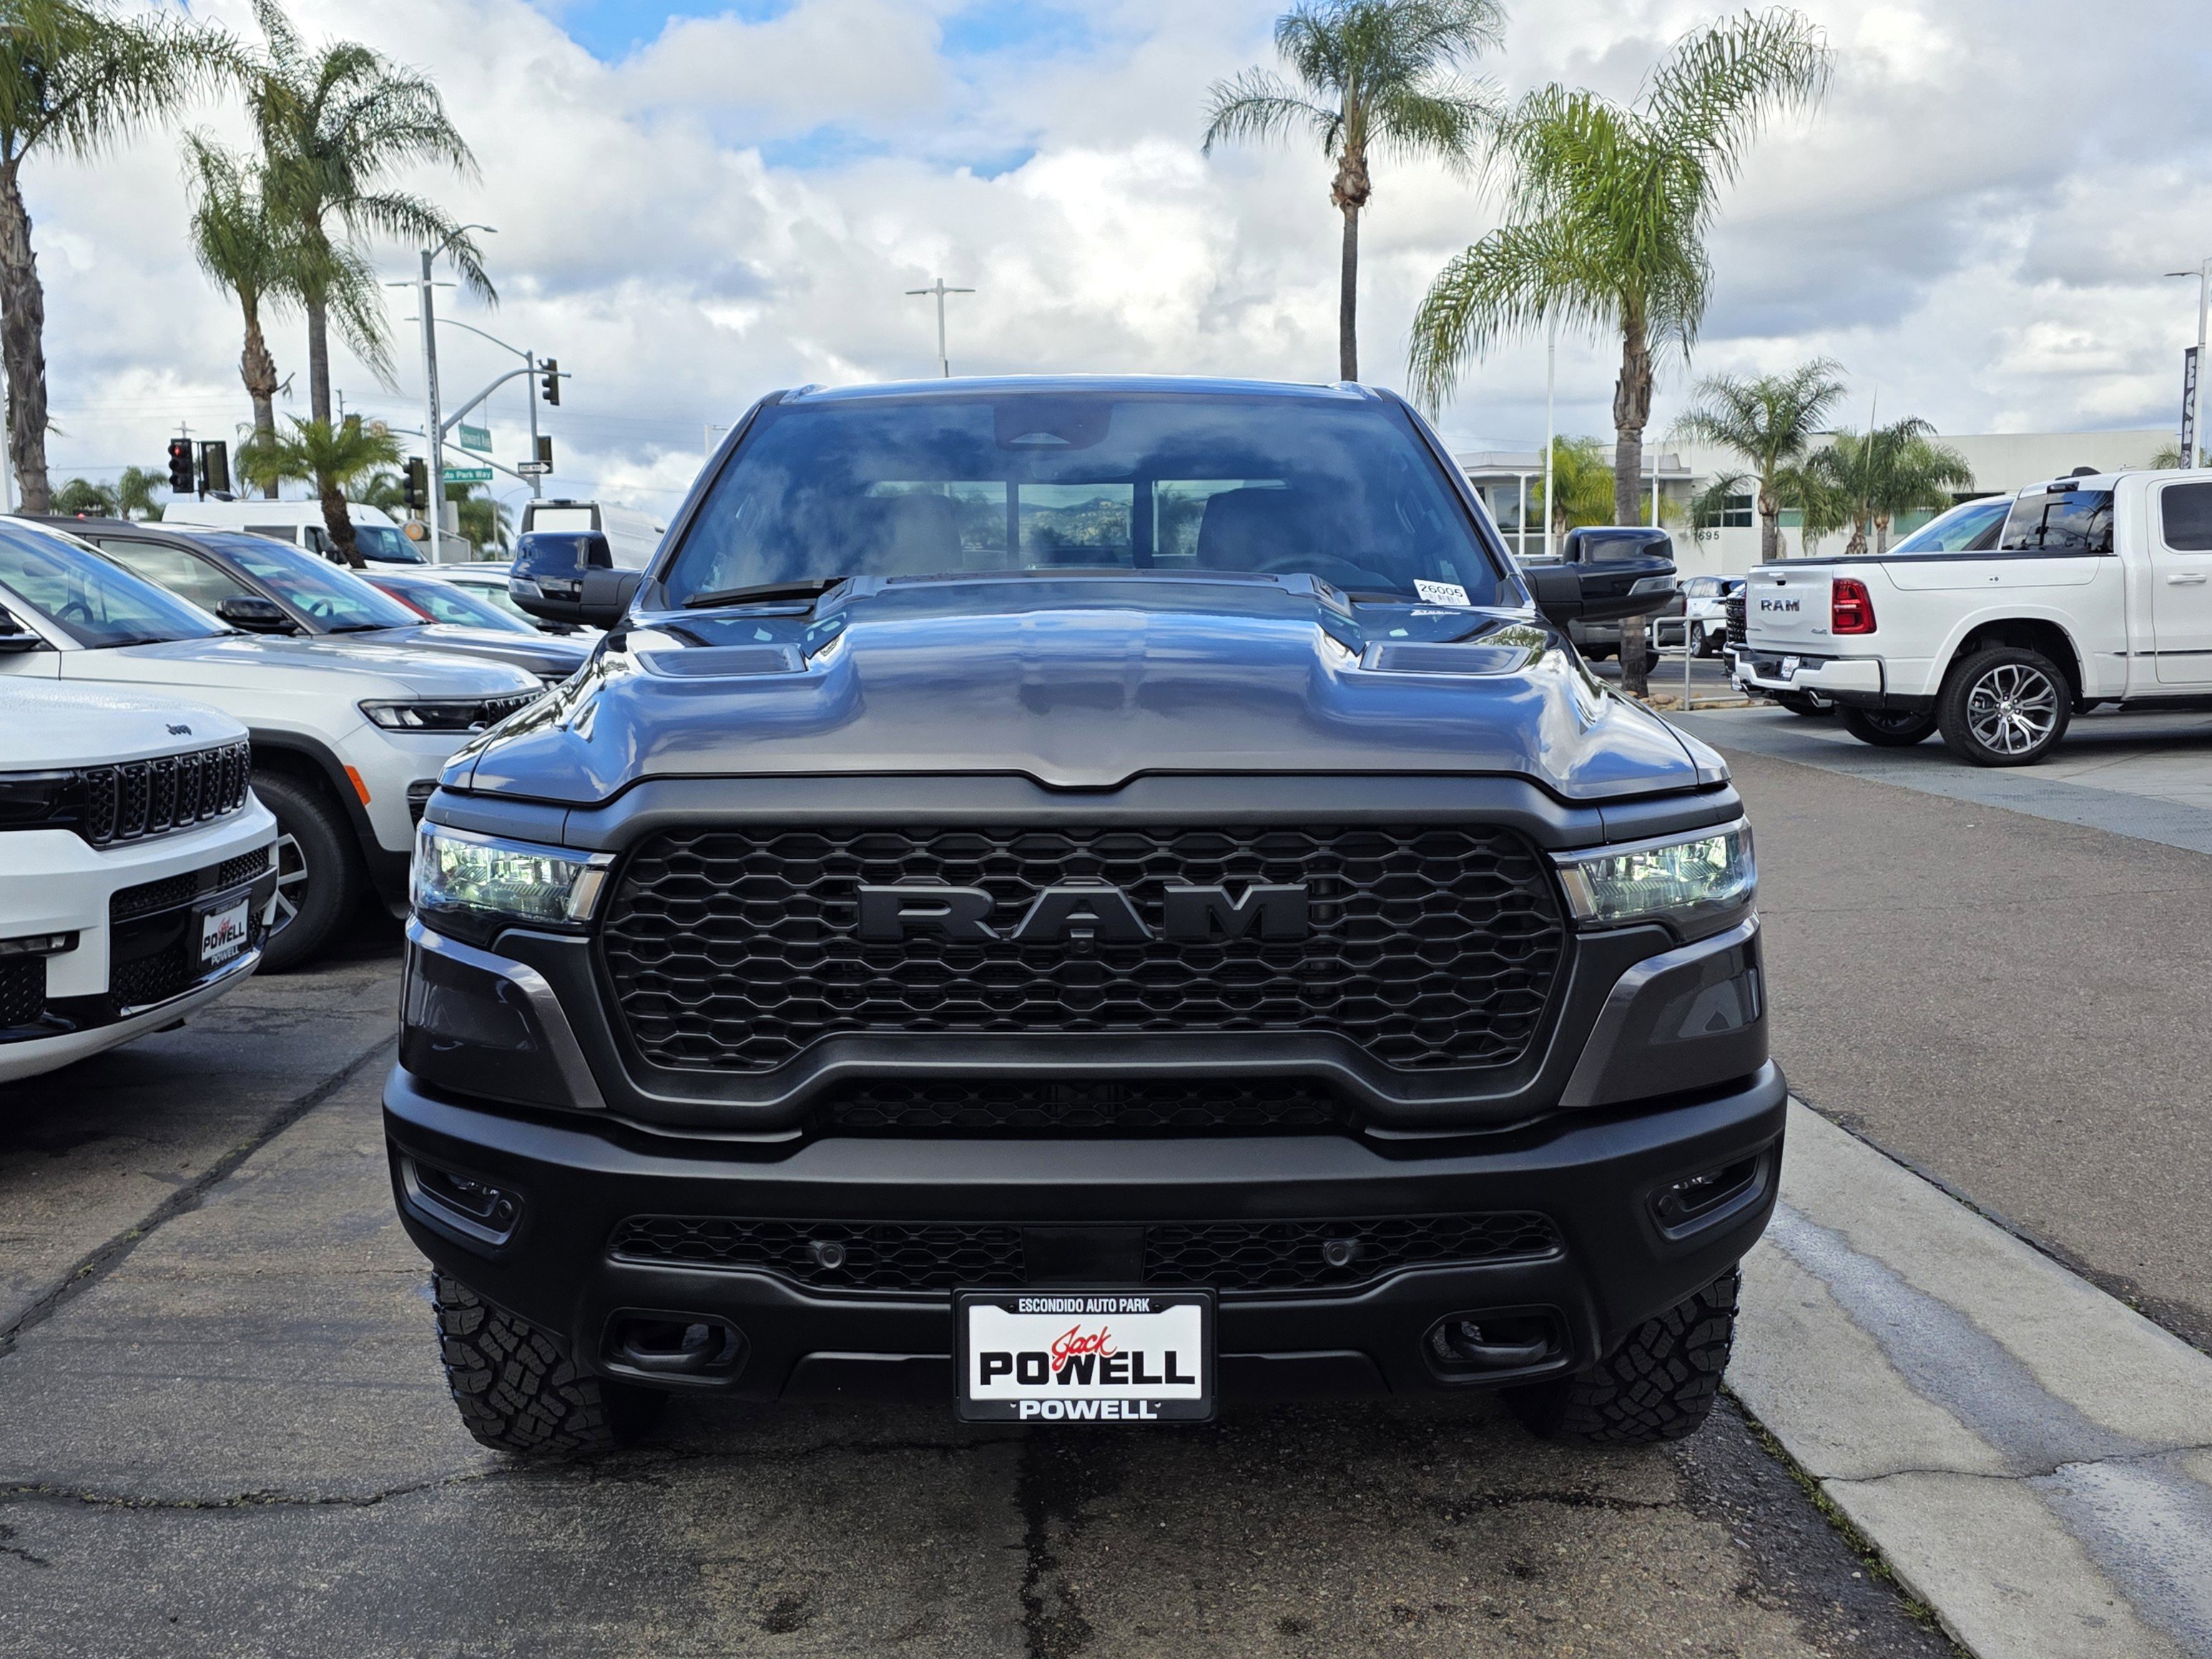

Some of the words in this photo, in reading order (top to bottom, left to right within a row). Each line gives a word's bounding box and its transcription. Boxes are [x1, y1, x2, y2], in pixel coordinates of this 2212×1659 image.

[2183, 356, 2196, 444] RAM
[443, 471, 455, 479] uto
[456, 471, 474, 479] Park
[476, 470, 491, 479] Way
[1418, 584, 1463, 598] 26005
[1760, 599, 1800, 611] RAM
[857, 883, 1309, 940] RAM
[203, 921, 245, 953] POWELL
[212, 945, 240, 966] POWELL
[1018, 1298, 1083, 1313] ESCONDIDO
[1086, 1298, 1116, 1313] AUTO
[1119, 1298, 1150, 1313] PARK
[1051, 1324, 1118, 1372] Jack
[980, 1350, 1196, 1386] POWELL
[1019, 1400, 1158, 1419] POWELL
